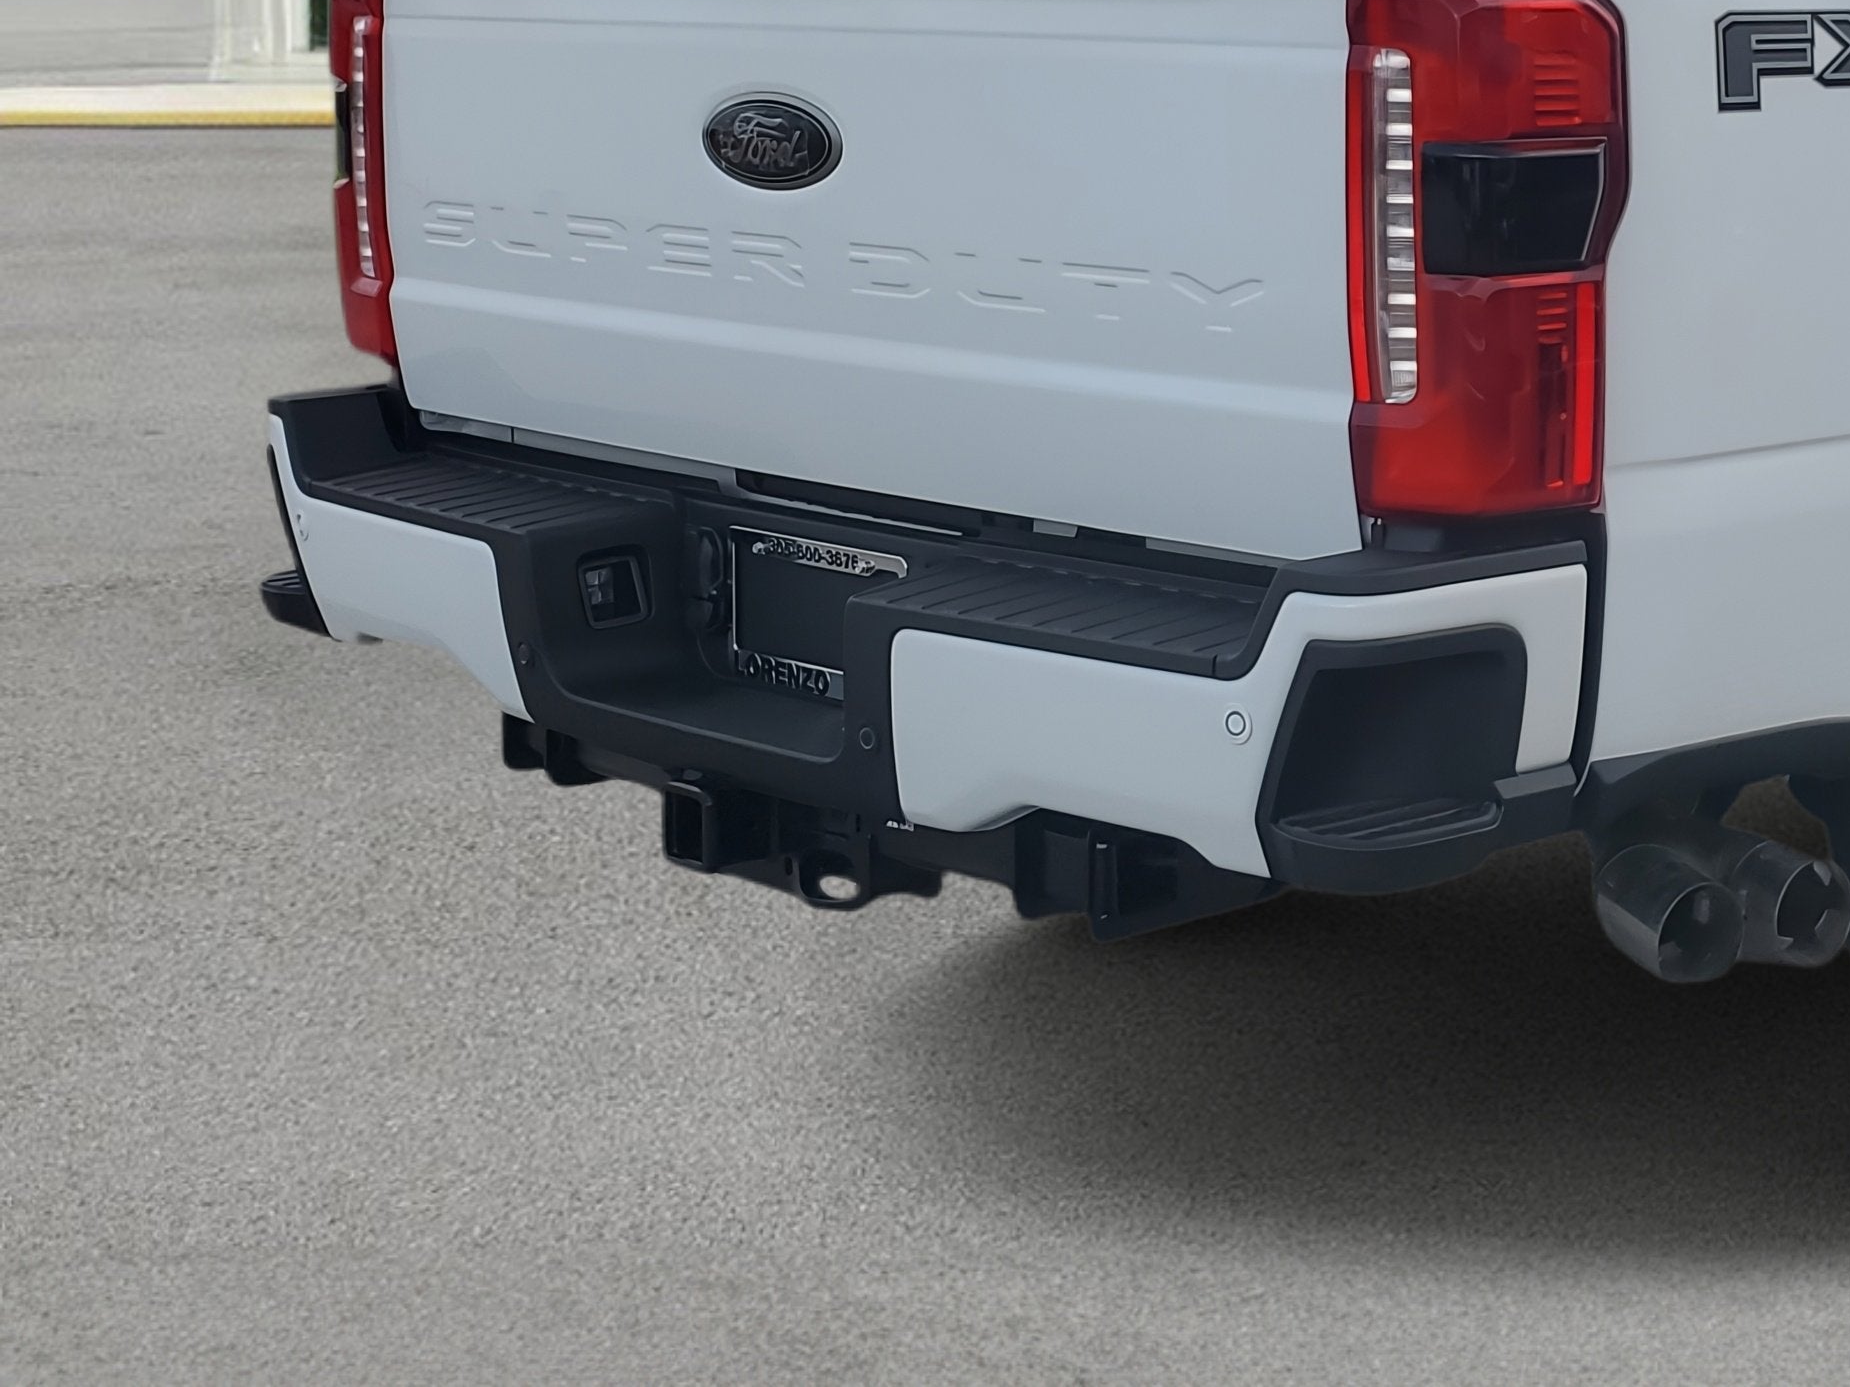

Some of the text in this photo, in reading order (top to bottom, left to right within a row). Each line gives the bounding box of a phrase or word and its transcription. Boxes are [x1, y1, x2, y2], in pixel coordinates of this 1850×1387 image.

[719, 110, 809, 170] Ford
[422, 199, 1265, 335] SUPER DUTY
[735, 650, 831, 697] LORENZO
